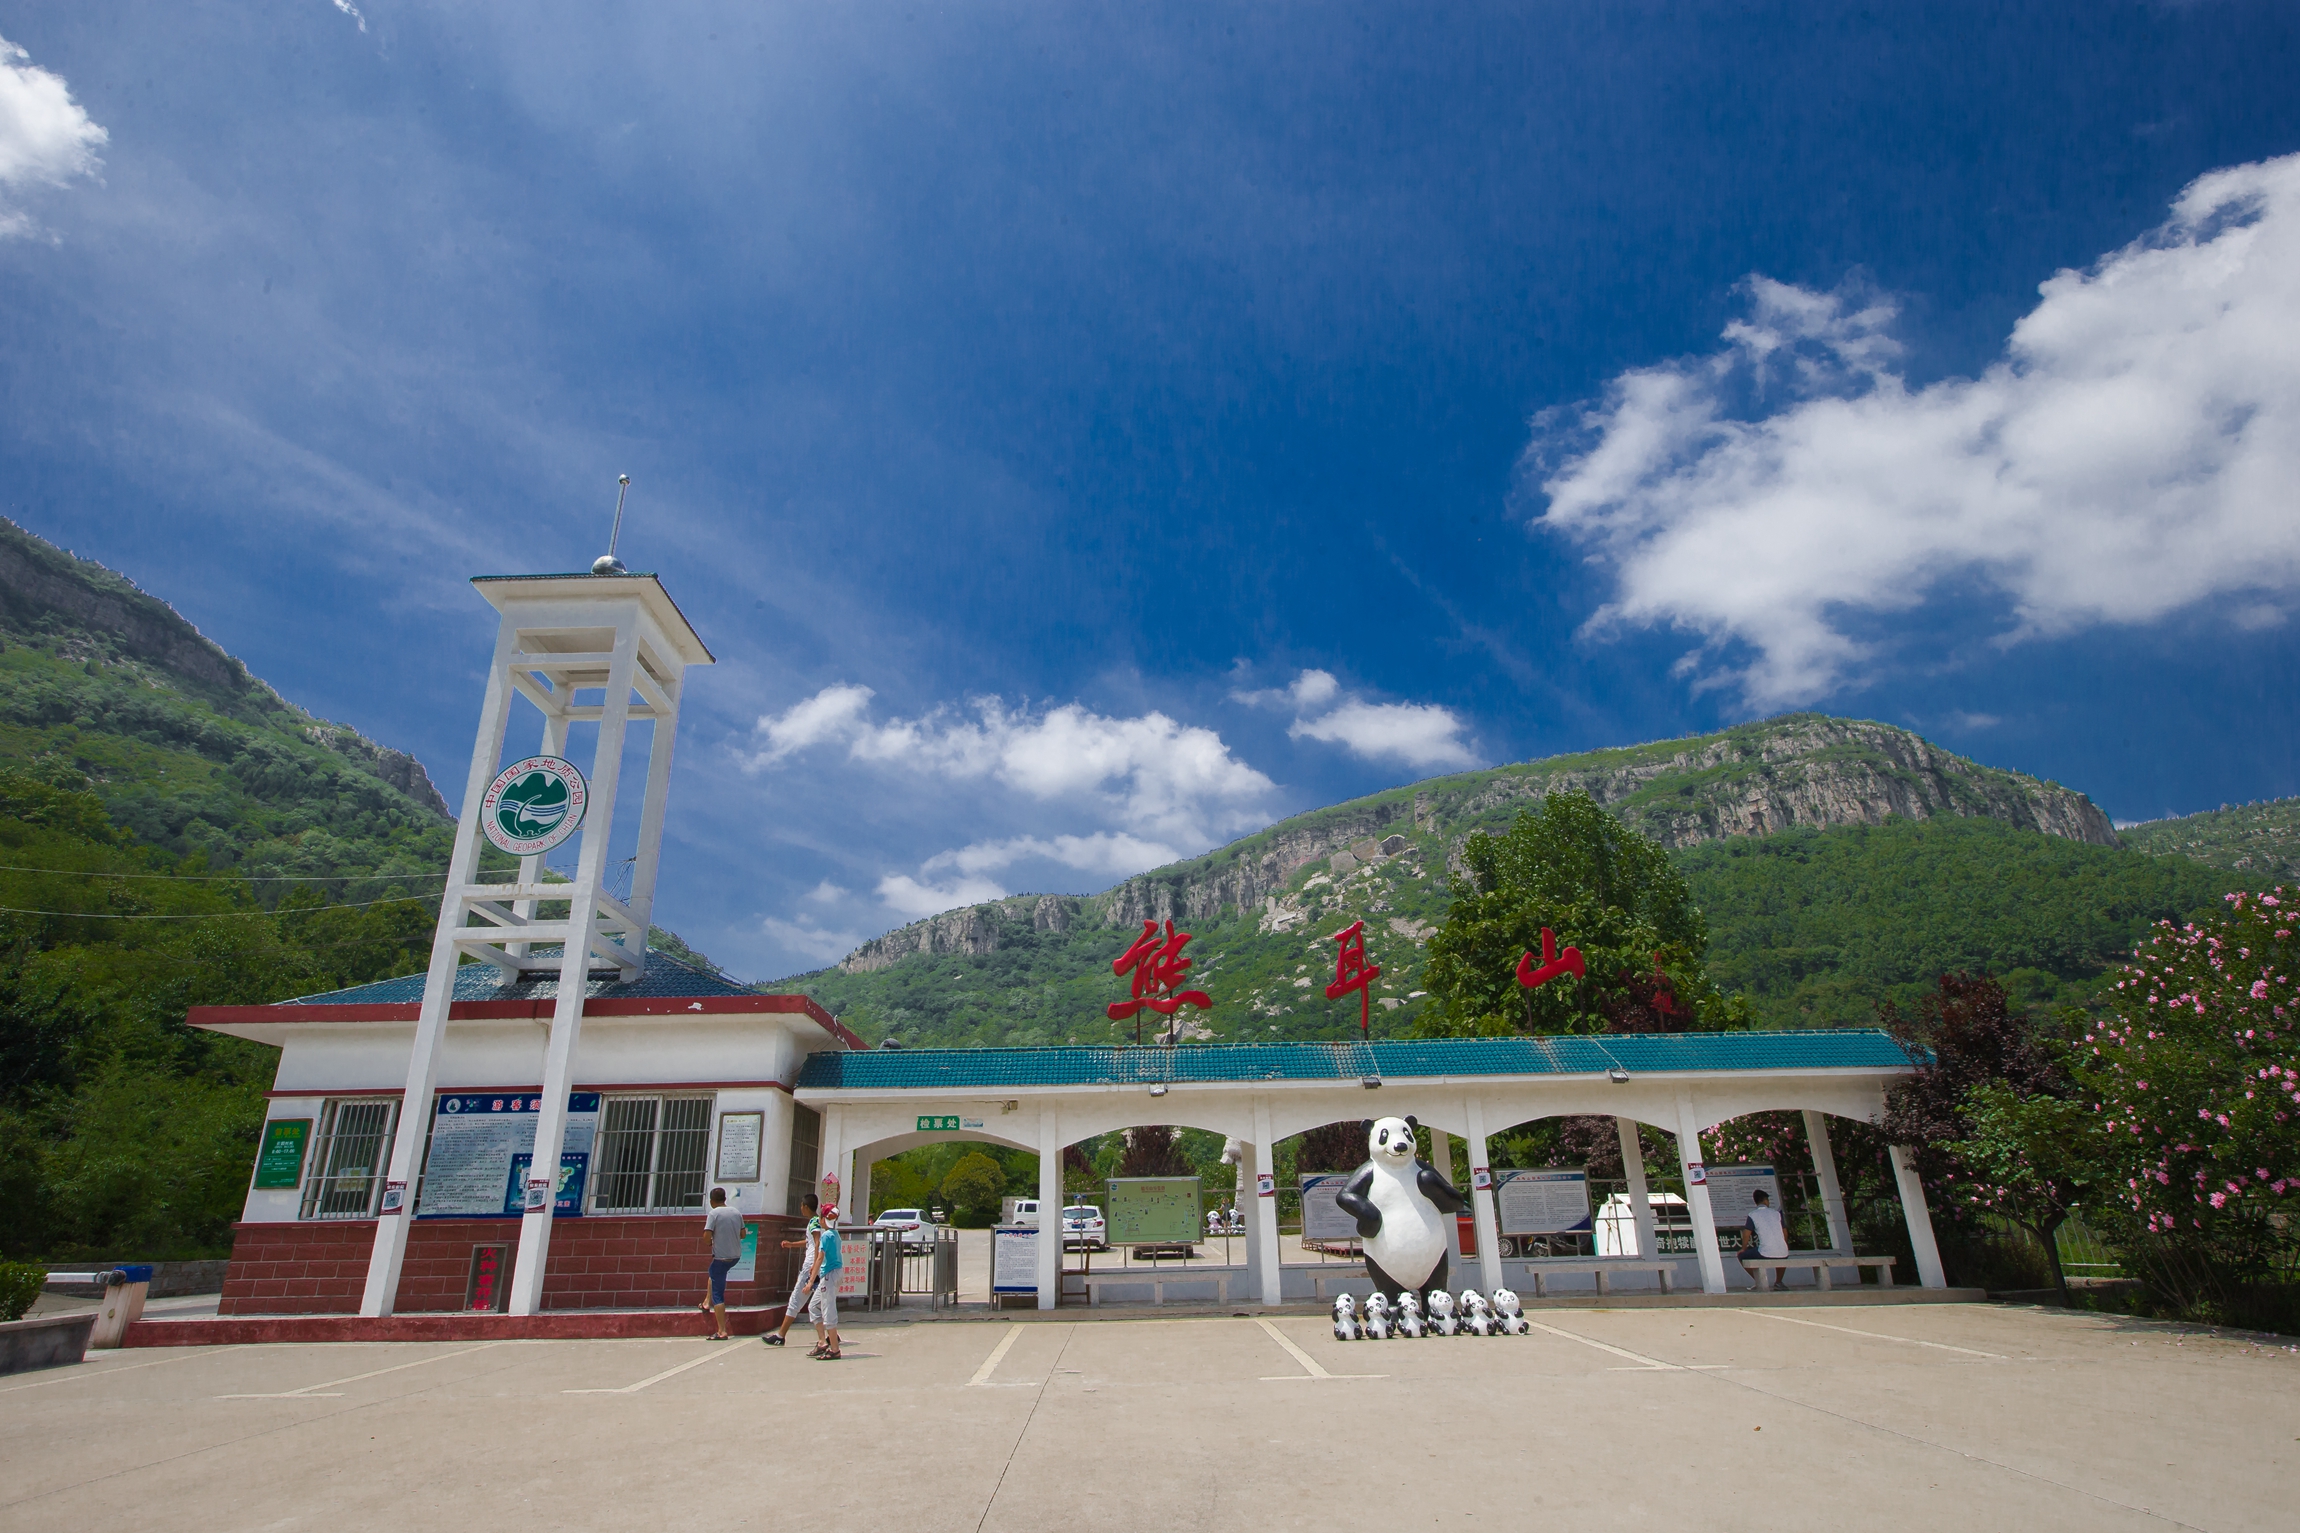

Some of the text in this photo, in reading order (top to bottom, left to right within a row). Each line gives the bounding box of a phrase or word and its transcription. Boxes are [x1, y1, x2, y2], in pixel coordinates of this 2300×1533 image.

[485, 758, 583, 808] 中国国家地质公园
[486, 813, 578, 852] NATIONAL GEOPARK OF CHIAN
[919, 1118, 957, 1129] 检票处
